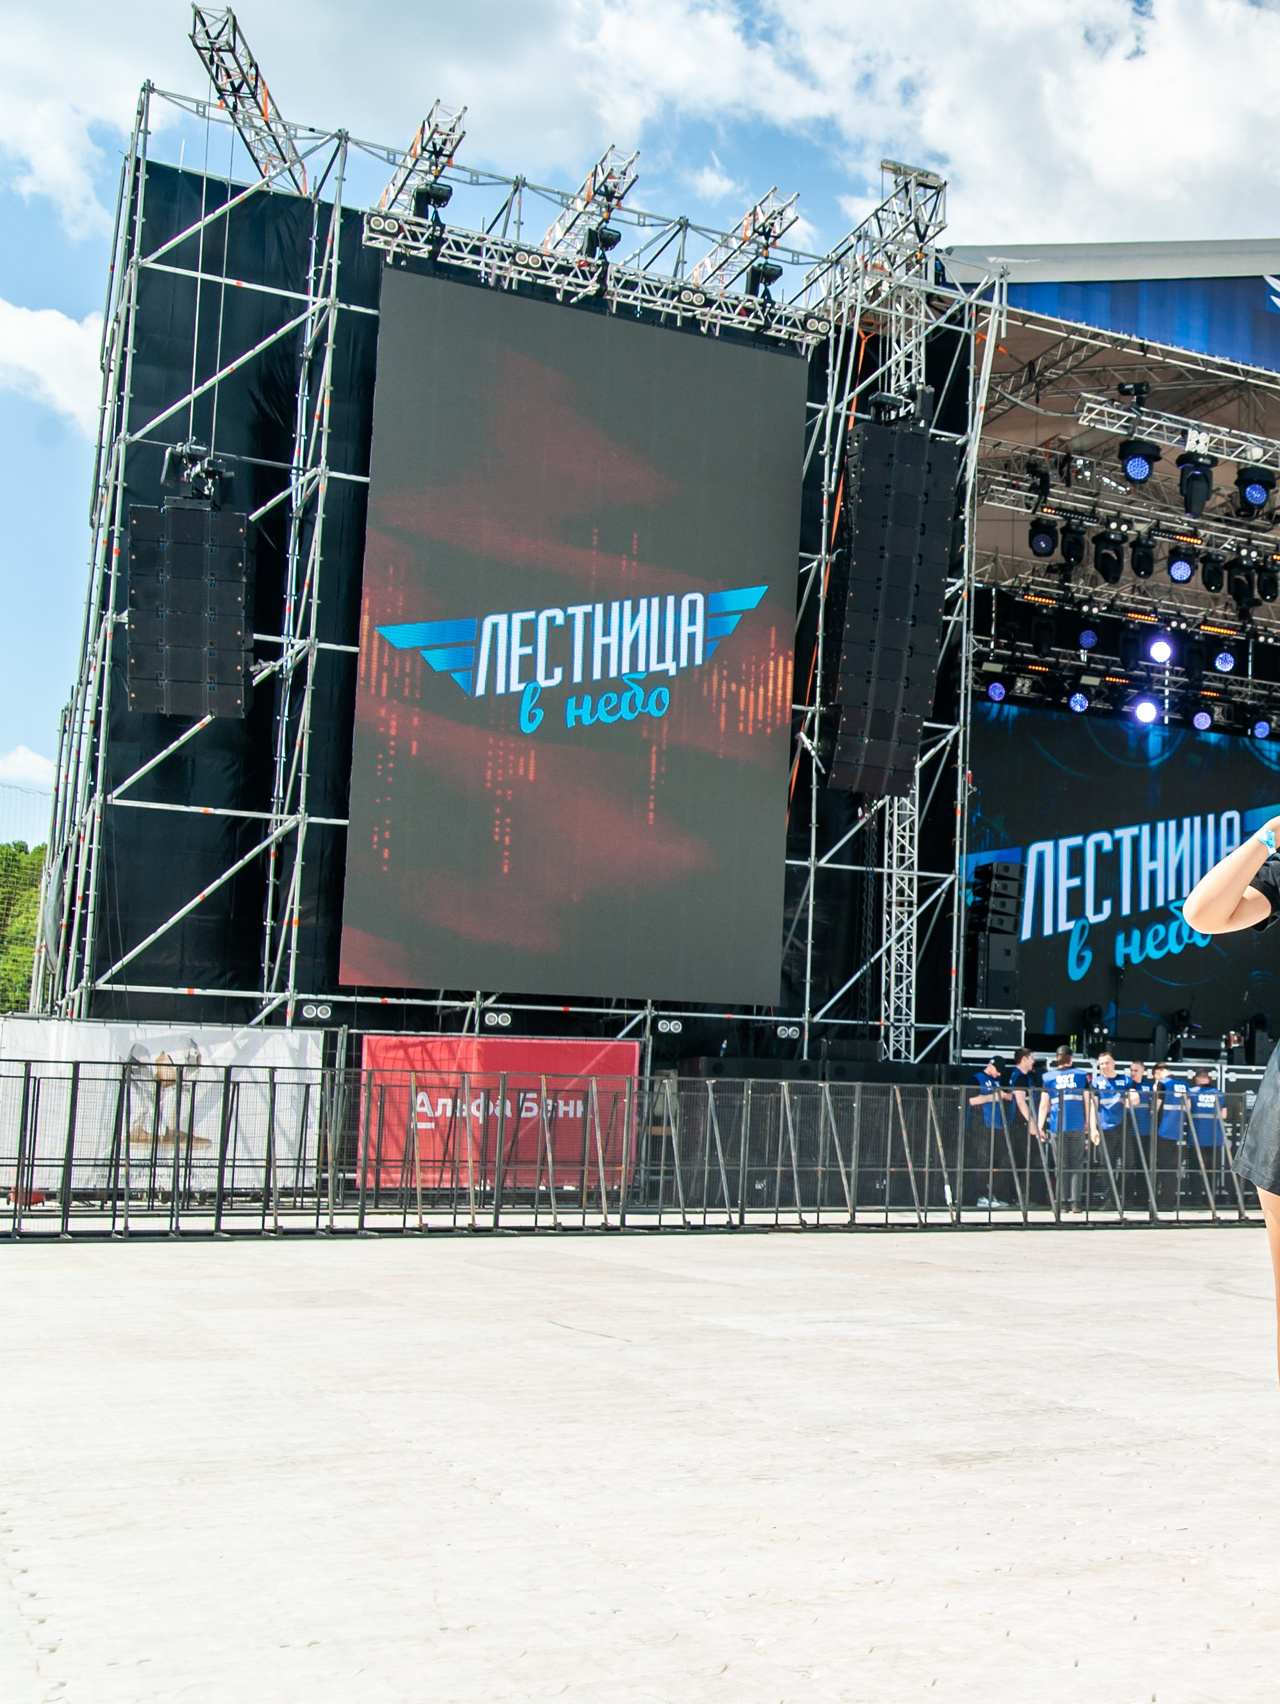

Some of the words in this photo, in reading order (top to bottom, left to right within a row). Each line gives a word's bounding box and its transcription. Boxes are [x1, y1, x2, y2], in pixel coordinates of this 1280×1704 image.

[474, 591, 705, 698] ЛЕСТНИЦА
[519, 681, 545, 734] в
[566, 671, 671, 728] небо
[1020, 809, 1242, 942] ЛЕСТНИЦА
[1067, 918, 1093, 982] в
